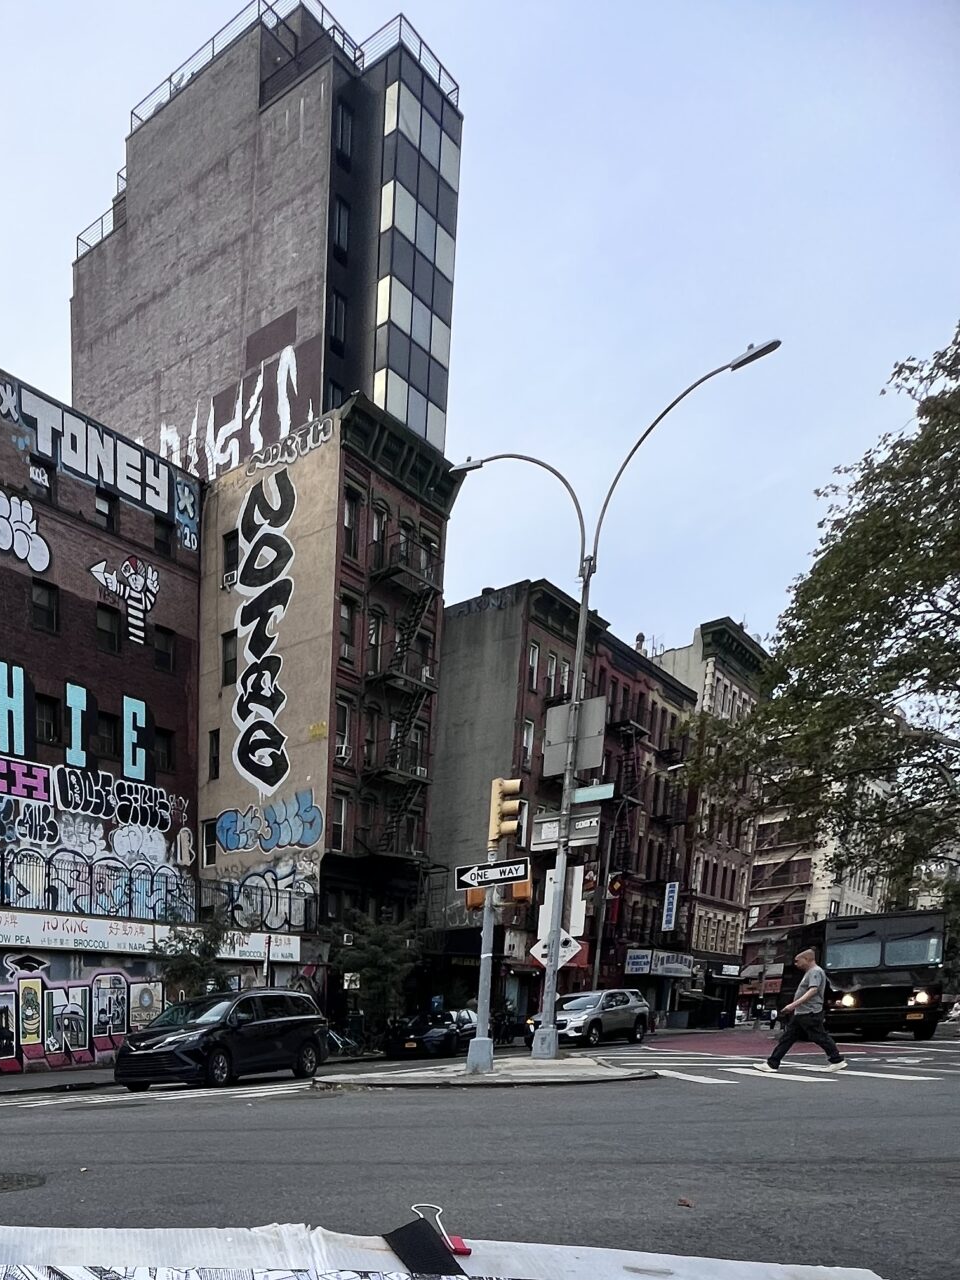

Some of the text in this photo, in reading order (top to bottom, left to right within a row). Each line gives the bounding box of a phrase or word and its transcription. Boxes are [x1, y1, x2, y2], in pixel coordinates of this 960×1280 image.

[21, 388, 170, 514] TONEY
[246, 418, 334, 477] NORTH
[470, 866, 521, 882] ONE WAY
[62, 918, 88, 934] KING
[15, 935, 31, 944] PEA
[73, 939, 110, 949] BROCCOLI
[128, 942, 147, 951] NAPA
